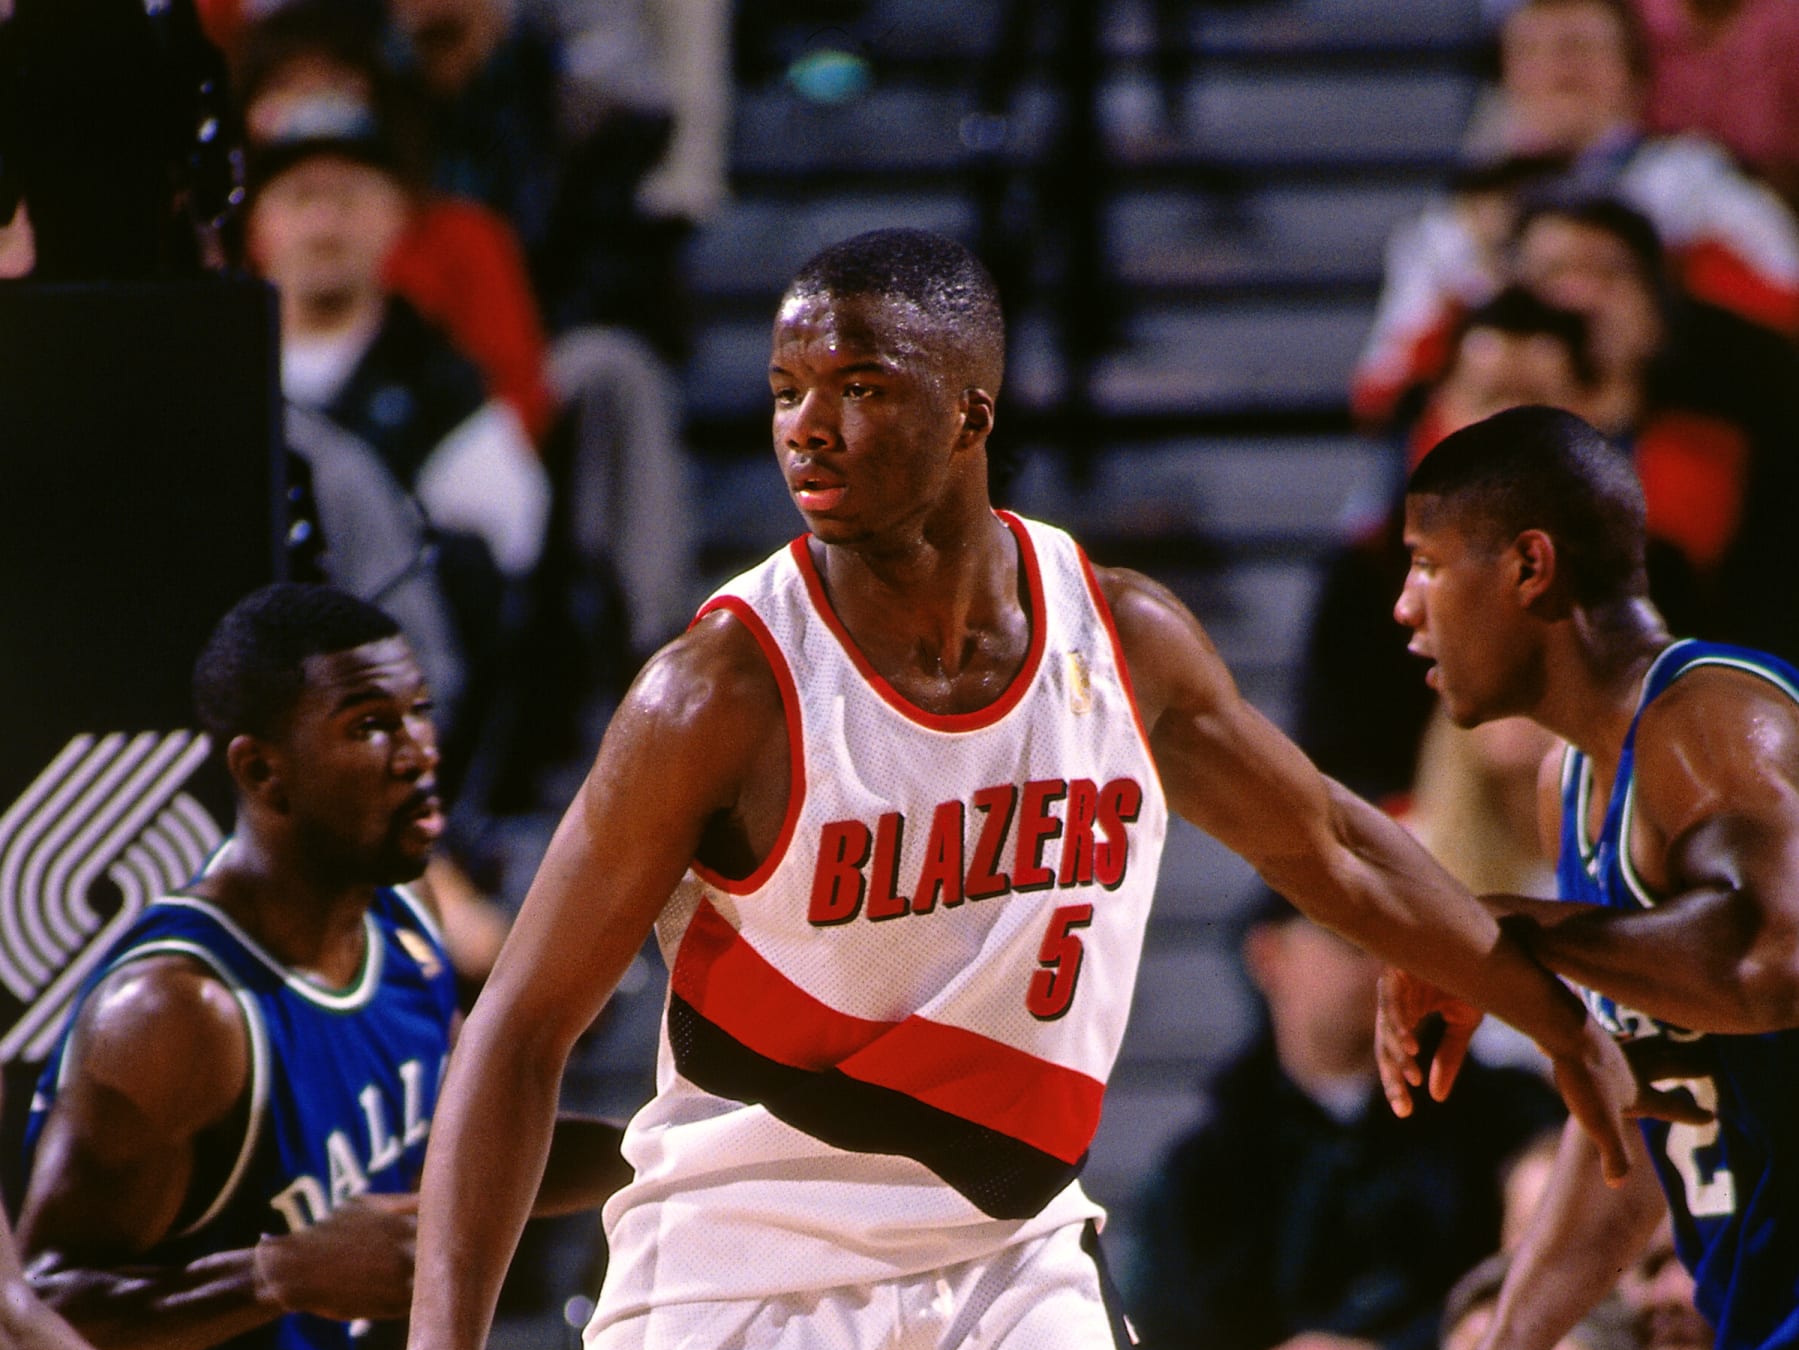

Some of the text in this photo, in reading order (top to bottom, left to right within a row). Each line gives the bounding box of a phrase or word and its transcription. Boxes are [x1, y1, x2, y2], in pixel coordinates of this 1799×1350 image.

[808, 777, 1142, 925] BLAZERS
[1026, 904, 1094, 1022] 5
[271, 1056, 449, 1232] DALL
[1650, 1075, 1736, 1217] 2
